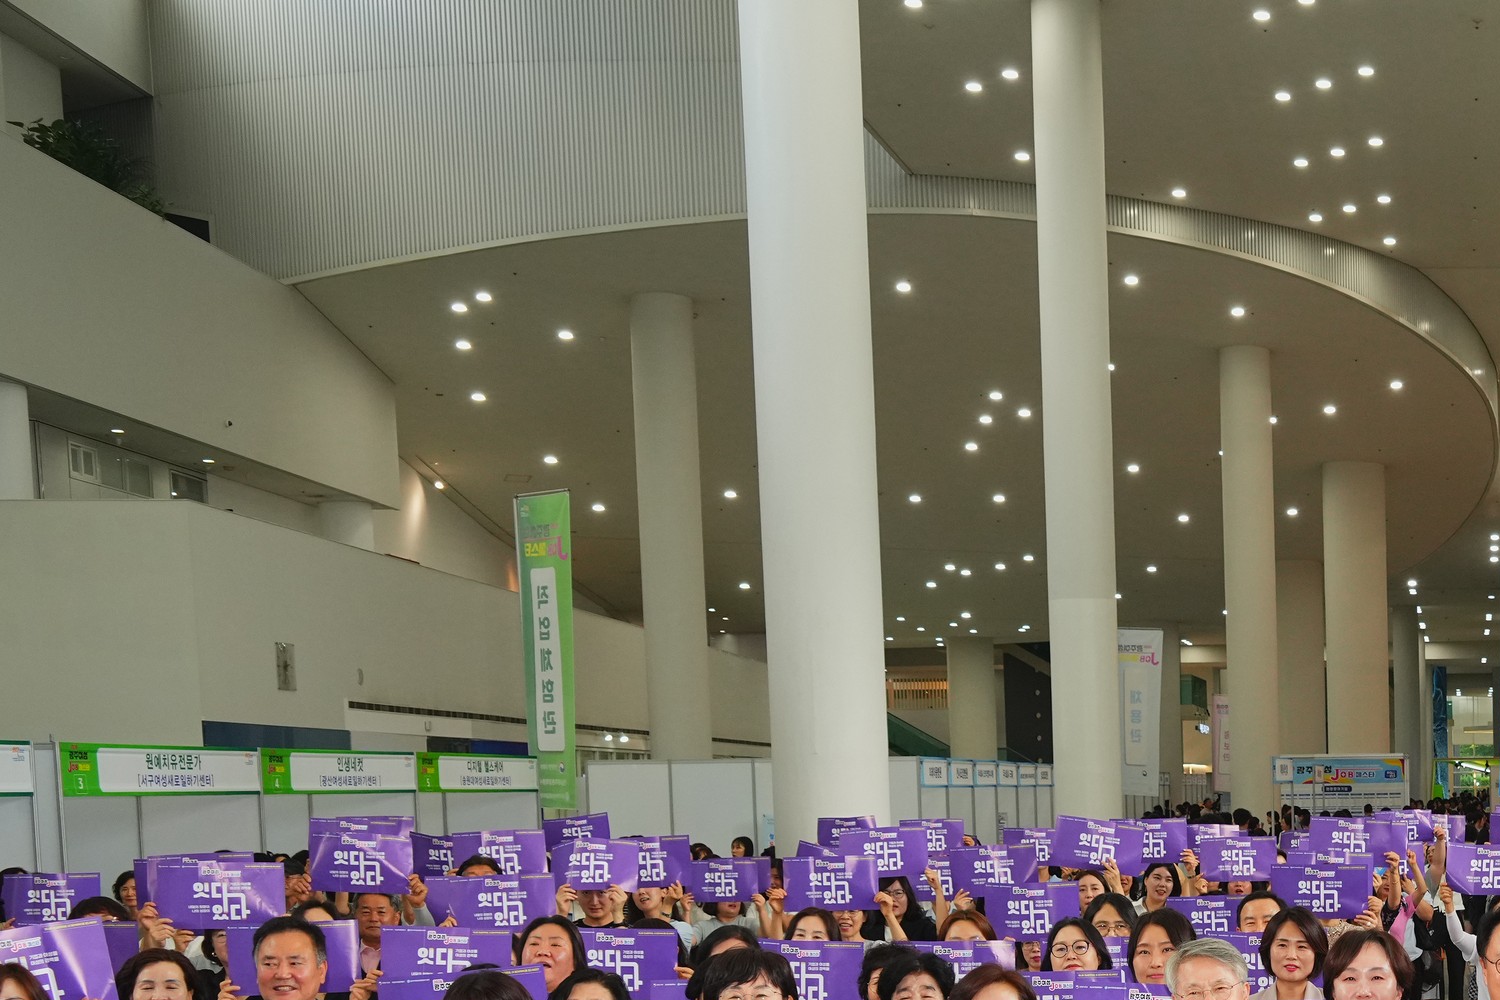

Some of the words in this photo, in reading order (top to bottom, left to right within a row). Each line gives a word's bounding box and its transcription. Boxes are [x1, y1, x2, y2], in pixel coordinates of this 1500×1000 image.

[145, 753, 202, 770] 원예치유전문가
[337, 757, 364, 772] 인생네컷
[467, 761, 482, 772] 디지털
[484, 761, 504, 773] 헬스케어
[1331, 769, 1354, 780] JOB
[77, 777, 84, 789] 3
[274, 778, 280, 788] 4
[809, 872, 838, 887] 잇다
[193, 882, 229, 899] 잇다
[212, 902, 250, 921] 있다
